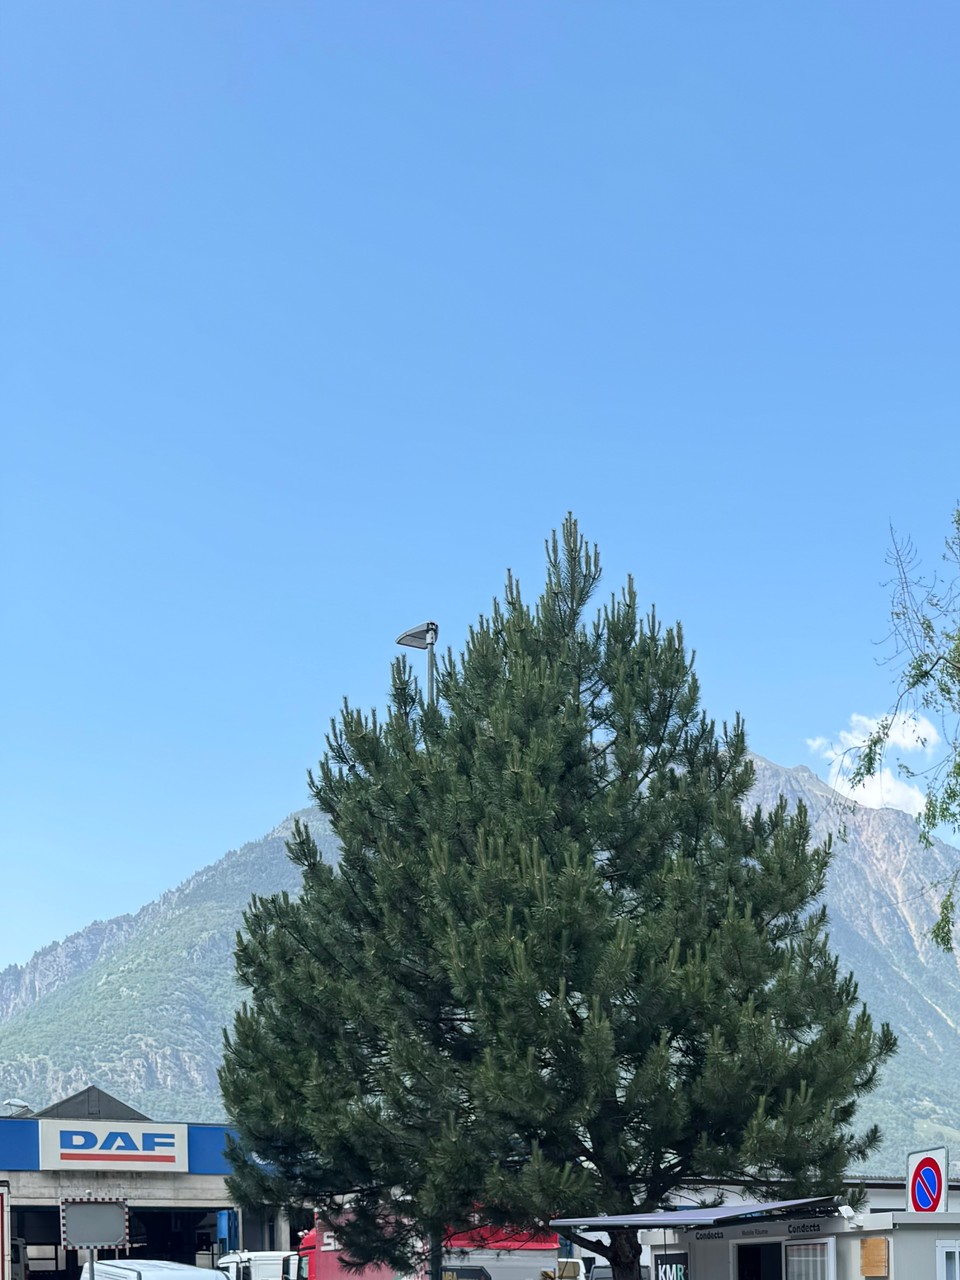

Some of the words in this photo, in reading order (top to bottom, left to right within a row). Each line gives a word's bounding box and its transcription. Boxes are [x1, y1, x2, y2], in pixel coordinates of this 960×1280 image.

[60, 1130, 175, 1151] DAF
[788, 1222, 820, 1234] Condecta
[695, 1230, 724, 1240] Condecta
